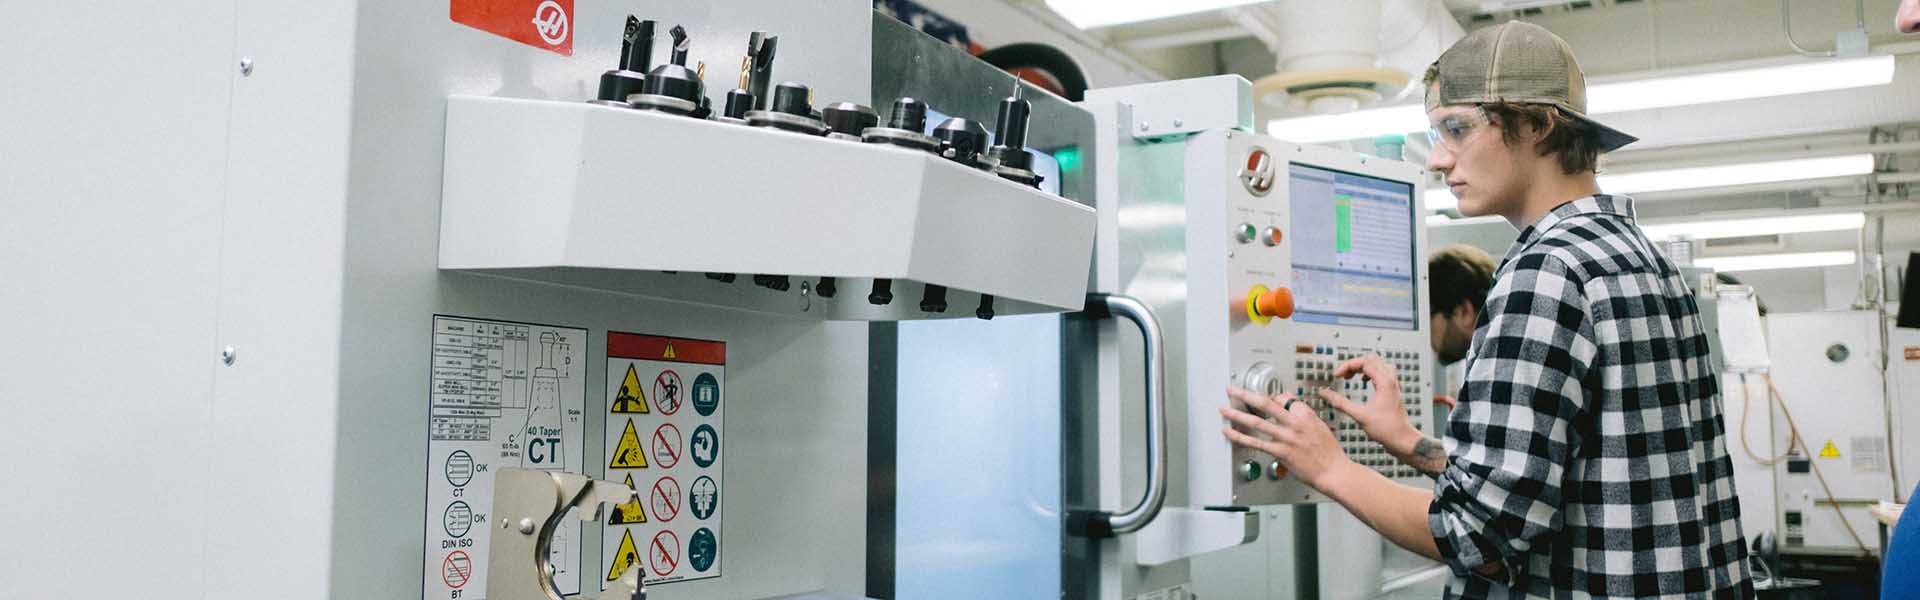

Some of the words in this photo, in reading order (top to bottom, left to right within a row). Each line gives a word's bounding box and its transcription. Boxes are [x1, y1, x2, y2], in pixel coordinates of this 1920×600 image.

[527, 426, 537, 436] 40
[540, 426, 560, 437] Taper
[509, 434, 515, 443] C
[528, 438, 560, 463] CT
[476, 464, 488, 472] OK
[453, 489, 464, 497] CT
[474, 514, 486, 523] OK
[442, 540, 456, 549] DIN
[459, 539, 473, 548] ISO
[451, 590, 463, 599] BT
